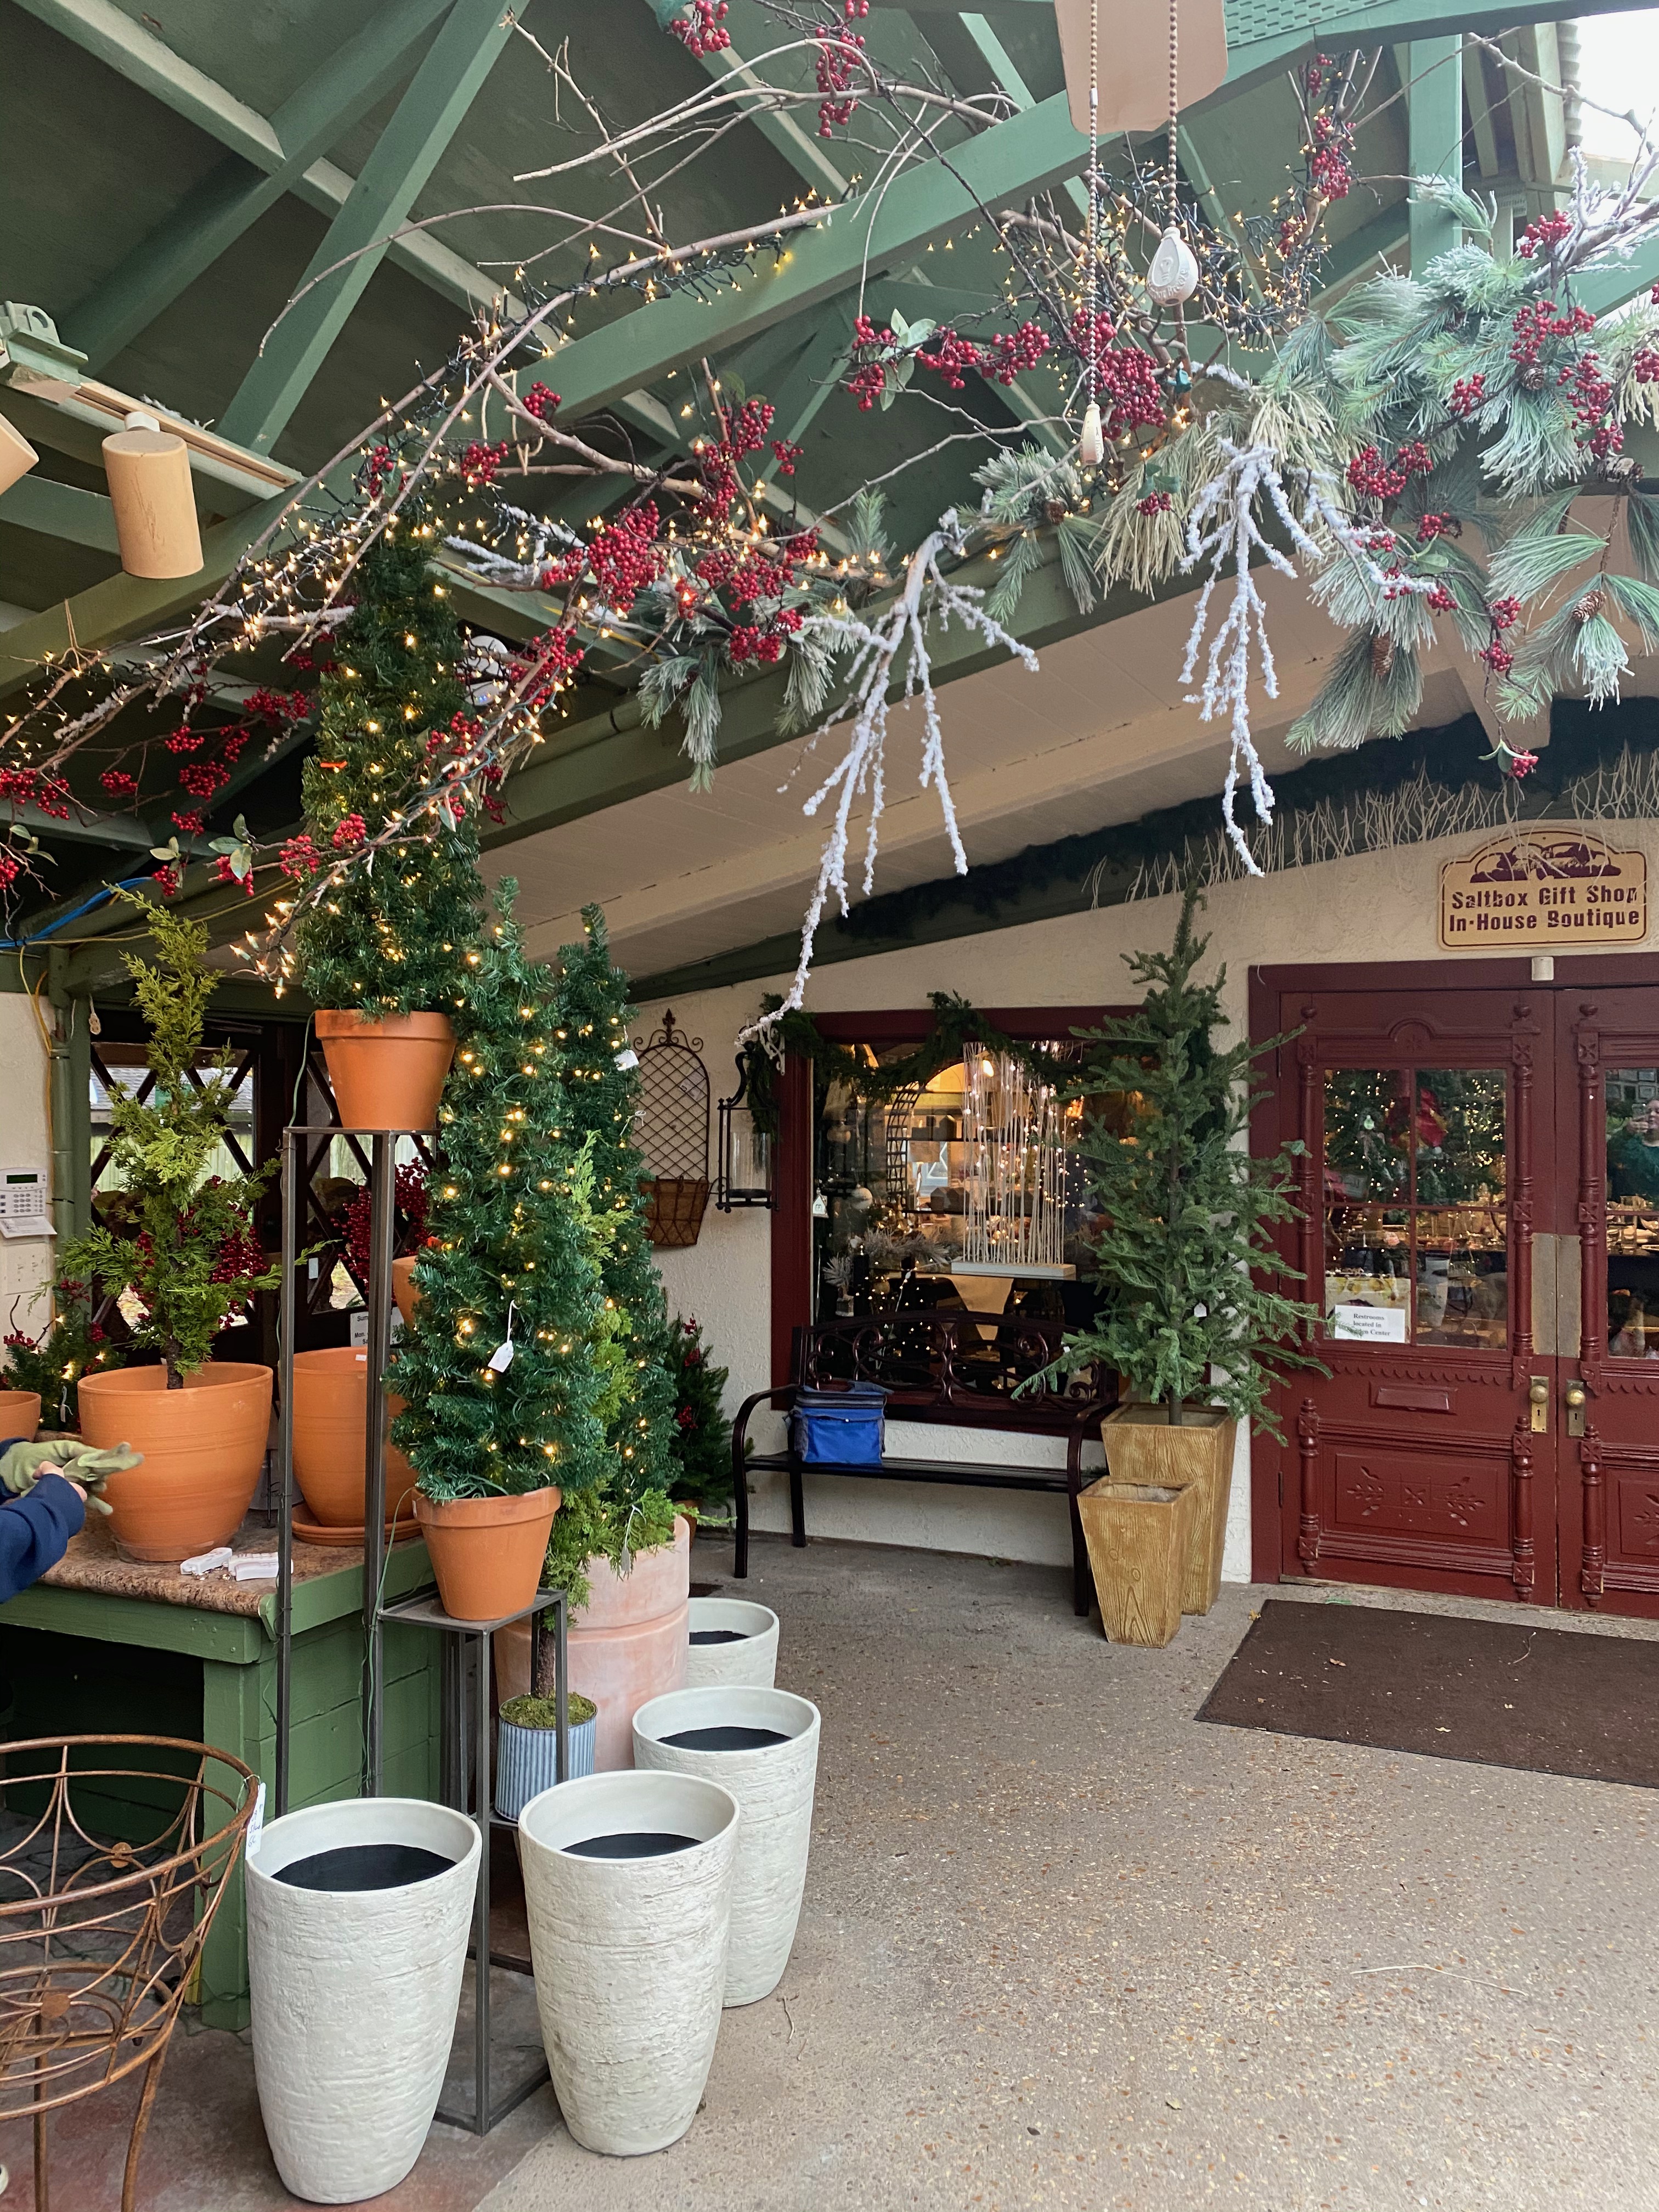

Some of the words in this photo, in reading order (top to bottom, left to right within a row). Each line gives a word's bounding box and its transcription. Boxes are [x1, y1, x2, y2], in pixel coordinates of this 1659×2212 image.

[1452, 889, 1528, 909] Saltbox
[1539, 885, 1576, 905] Gift
[1587, 884, 1637, 904] Shop
[1450, 912, 1537, 932] In-House
[1548, 908, 1639, 928] Boutique
